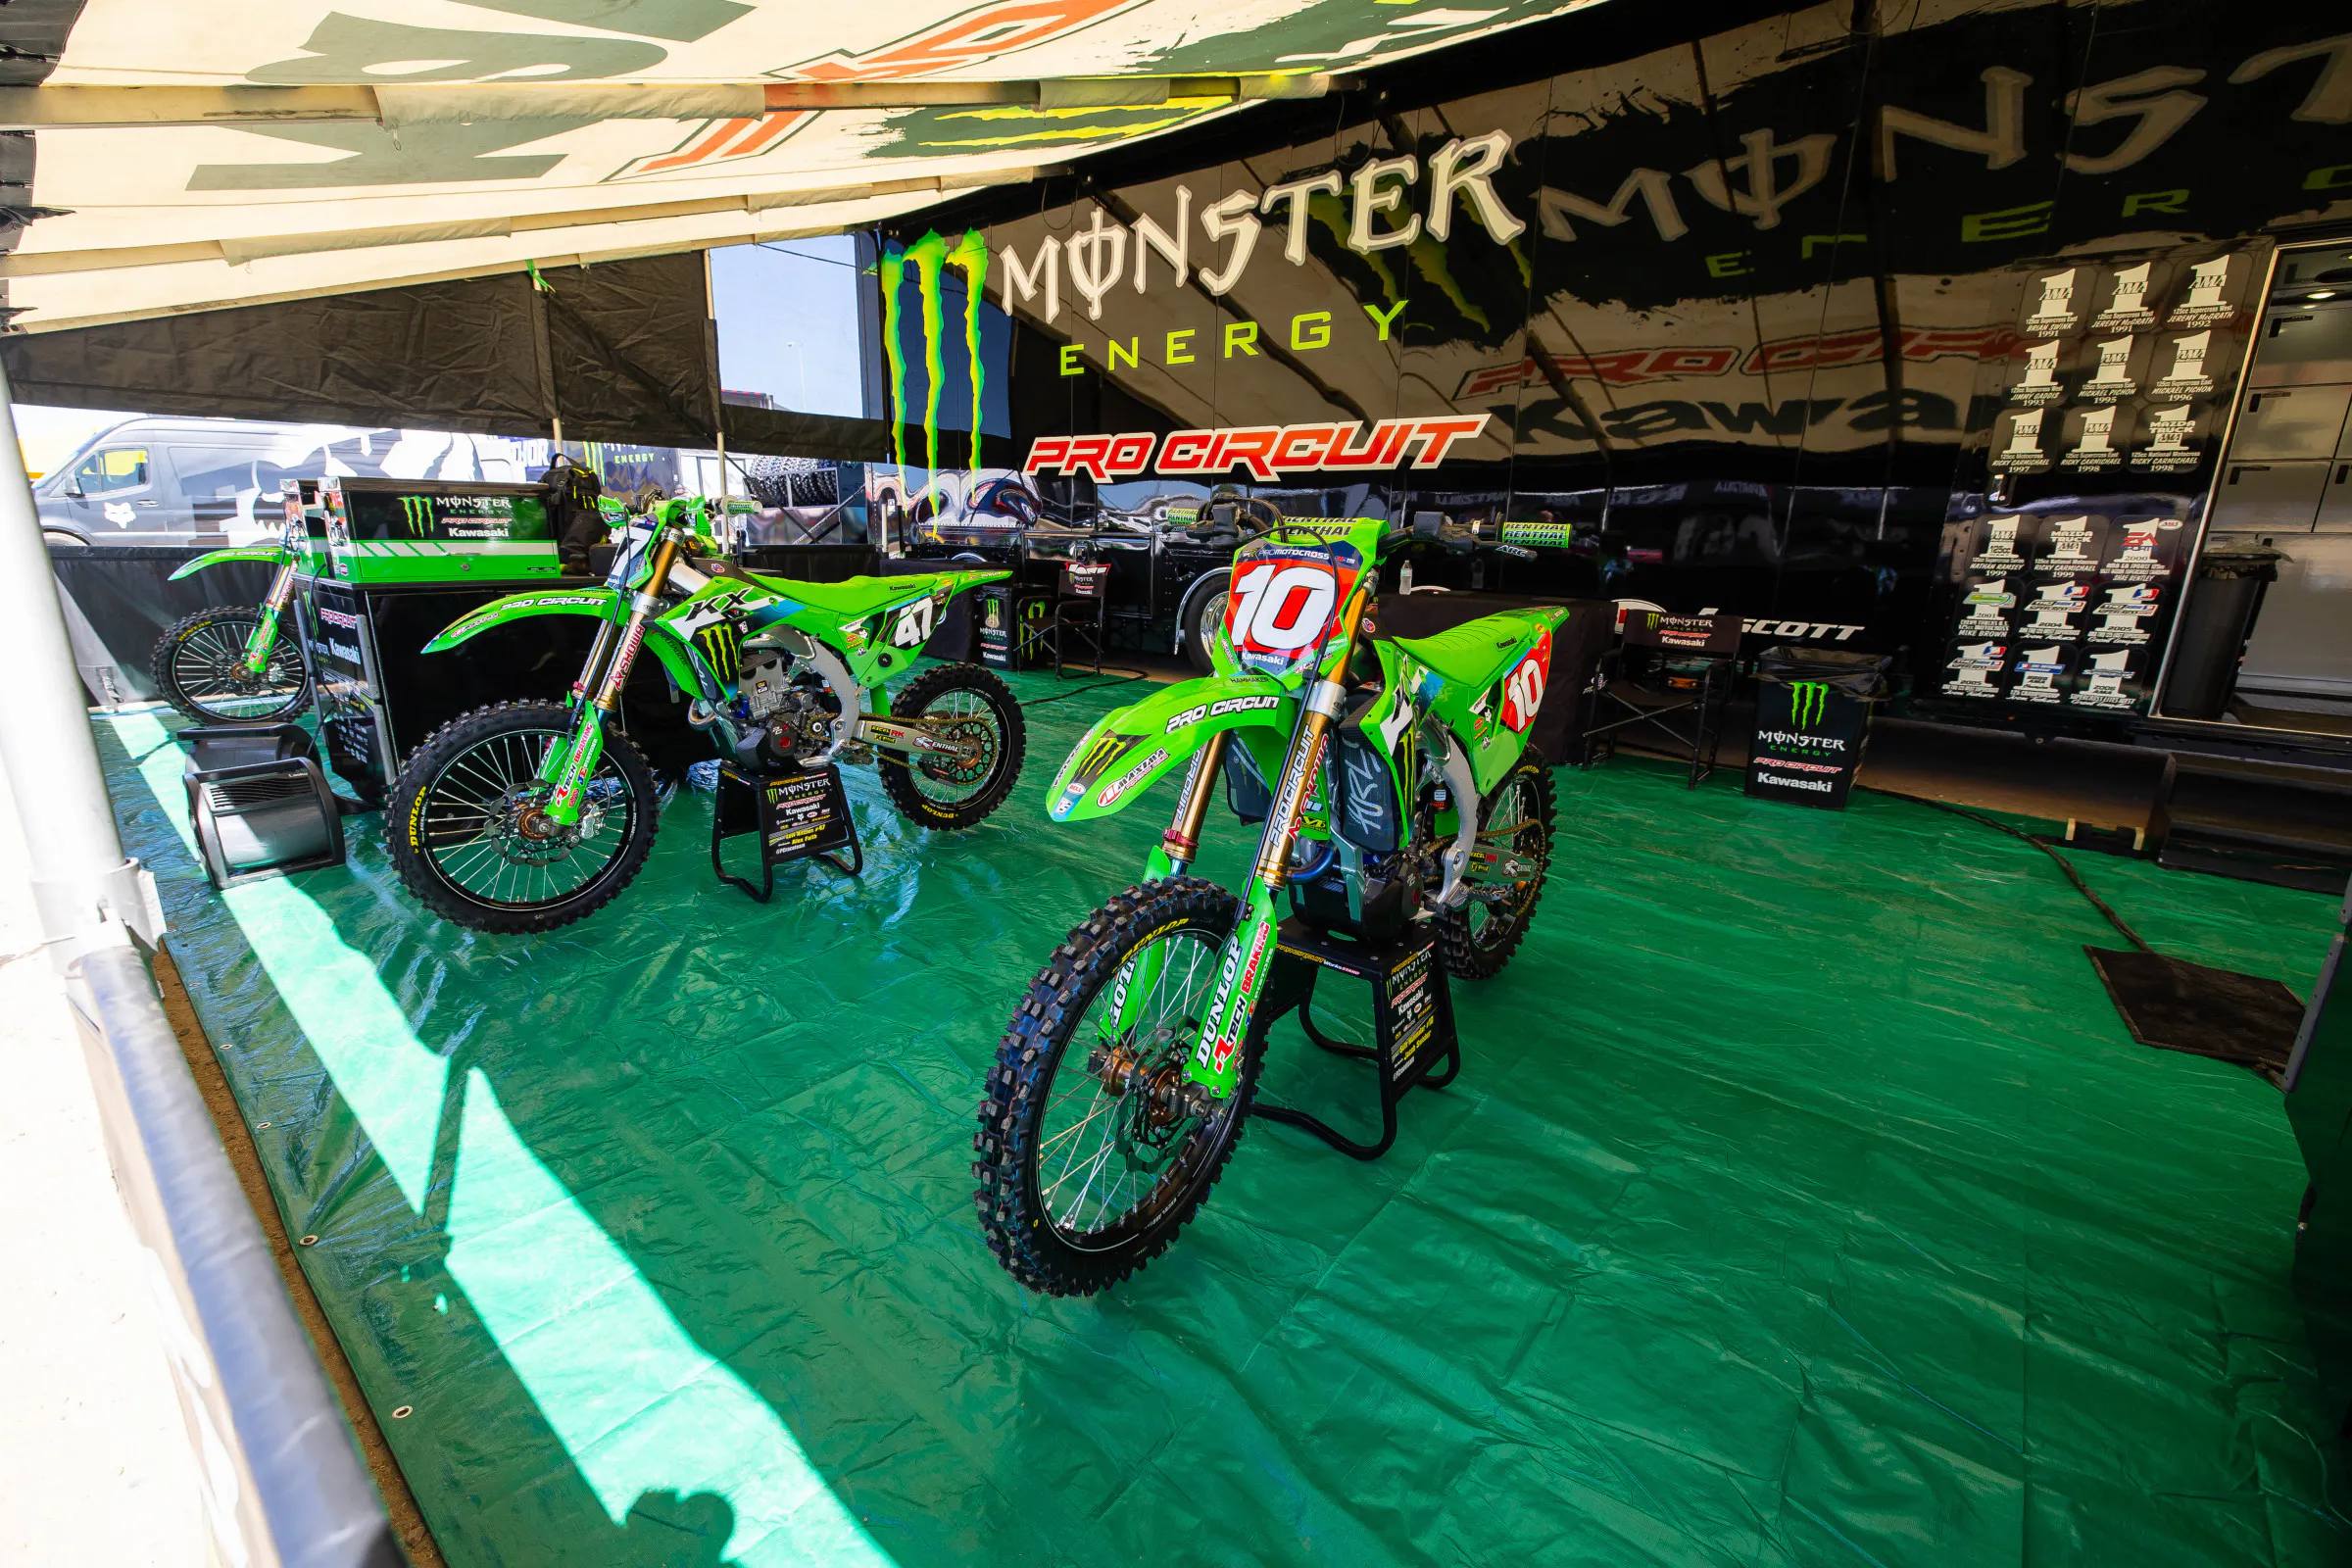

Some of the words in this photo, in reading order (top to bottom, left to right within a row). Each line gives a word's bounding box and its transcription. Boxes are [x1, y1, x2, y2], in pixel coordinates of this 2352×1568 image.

[999, 129, 1526, 324] MONSTER
[2091, 319, 2121, 328] JEREMY
[2121, 317, 2155, 325] McGRATH
[2168, 314, 2198, 323] JEREMY
[2199, 312, 2234, 320] McGRATH
[1060, 300, 1409, 377] ENERGY
[1023, 432, 1156, 484] PRO
[1153, 414, 1492, 482] CIRCUIT
[614, 453, 655, 465] ENERGY
[436, 496, 512, 508] MONSTER
[449, 527, 509, 537] Kawasaki
[1495, 545, 1528, 558] ARC
[537, 597, 608, 607] CIRCUIT
[685, 586, 755, 622] KX
[1231, 564, 1339, 650] 10
[895, 597, 933, 647] 47
[1659, 615, 1713, 628] MONSTER
[980, 627, 1006, 637] MONSTER
[1662, 636, 1705, 647] Kawasaki
[329, 637, 361, 664] Kawasaki
[620, 623, 645, 671] SHOWA
[1496, 636, 1517, 650] Kawasaki
[983, 652, 1006, 662] Kawasaki
[1241, 652, 1285, 665] Kawasaki
[1507, 659, 1544, 732] 10
[1165, 704, 1208, 734] PRO
[573, 721, 593, 763] BRAKING
[891, 729, 905, 739] RK
[1757, 730, 1846, 752] MONSTER
[1770, 745, 1831, 758] ENERGY
[1753, 757, 1786, 767] PRO
[1784, 760, 1842, 774] CIRCUIT
[778, 778, 831, 796] MONSTER
[1268, 801, 1293, 848] PRO
[1284, 723, 1316, 804] CIRCUIT
[1757, 772, 1833, 793] Kawasaki
[410, 786, 426, 847] DUNLOP
[786, 803, 820, 815] Kawasaki
[921, 804, 955, 818] DUNLOP
[1120, 918, 1190, 964] DUNLOP
[1241, 920, 1270, 995] BRAKING
[1196, 934, 1243, 1070] DUNLOP
[1398, 987, 1424, 1015] Kawasaki
